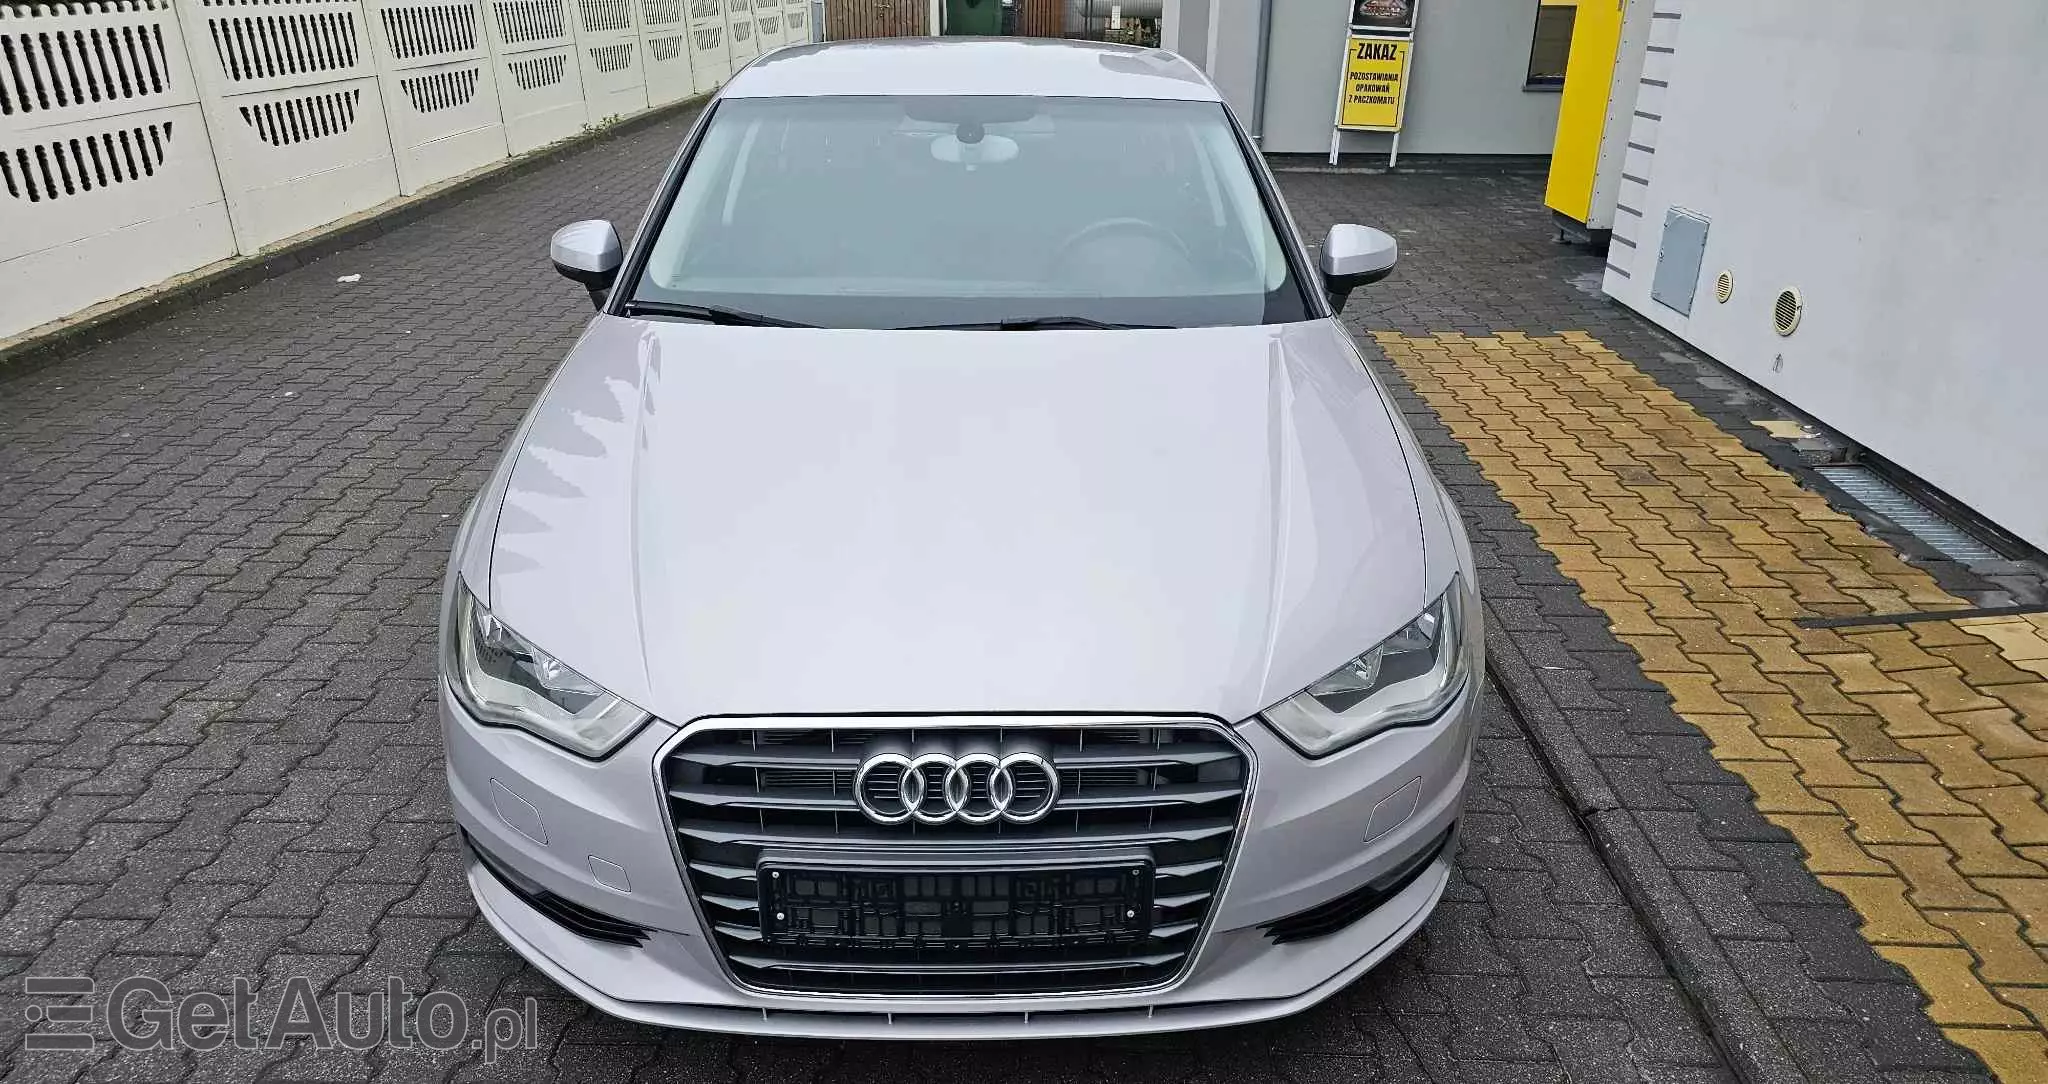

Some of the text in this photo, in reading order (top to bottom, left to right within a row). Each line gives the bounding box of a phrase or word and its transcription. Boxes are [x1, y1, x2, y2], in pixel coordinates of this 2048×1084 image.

[1357, 43, 1397, 60] ZAKAZ
[1349, 72, 1398, 81] POZOSTAWIANIA
[1355, 83, 1390, 92] OPAKOWAŃ
[1353, 95, 1395, 104] PACZKOMATU
